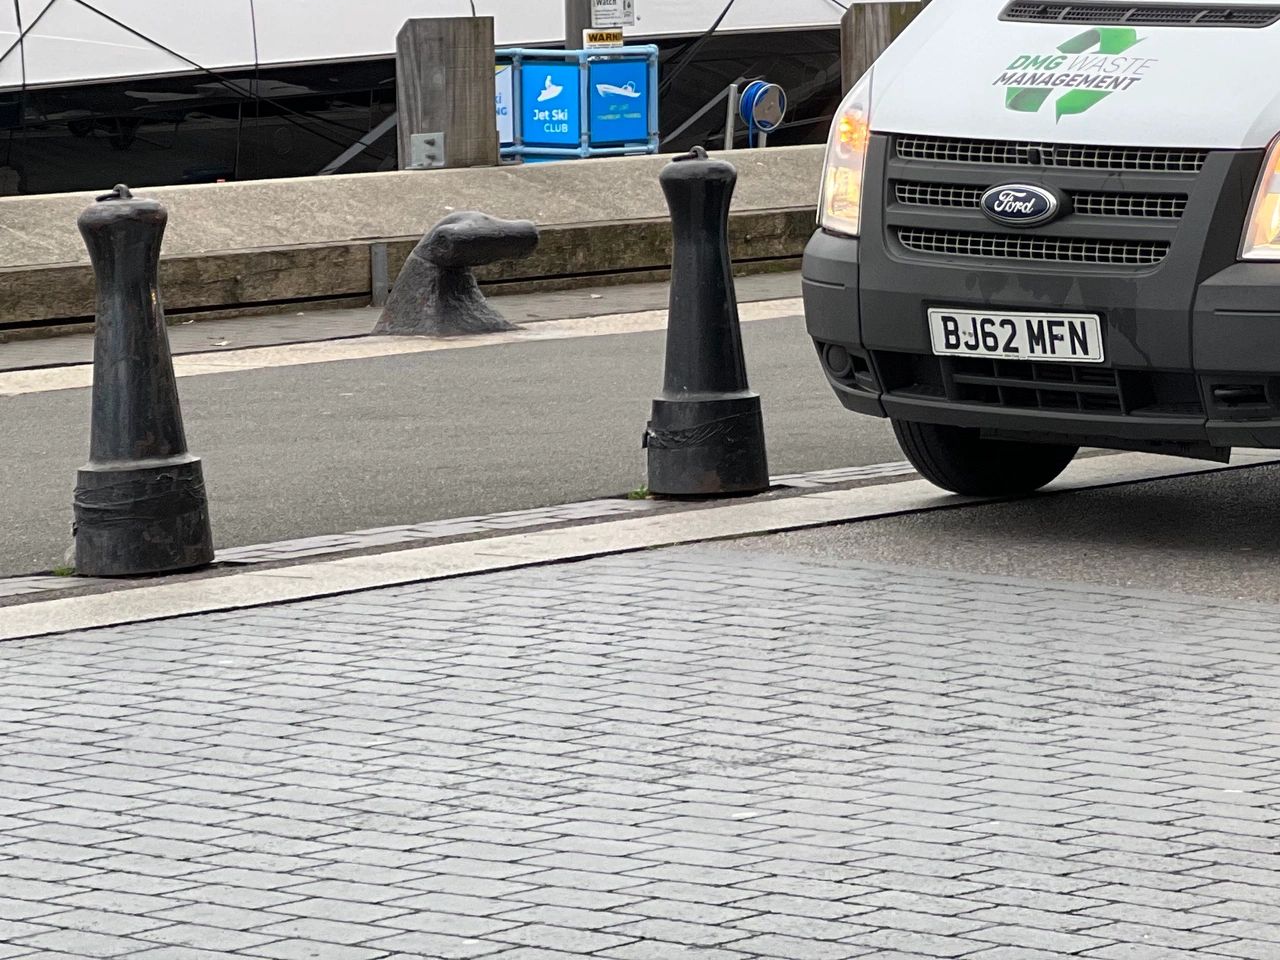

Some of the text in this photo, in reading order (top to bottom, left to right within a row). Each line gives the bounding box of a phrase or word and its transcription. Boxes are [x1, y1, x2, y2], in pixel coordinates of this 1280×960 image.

[588, 32, 623, 41] WARN
[1006, 55, 1159, 76] DMG WASTE
[992, 72, 1142, 91] MANAGEMENT
[533, 109, 568, 121] Jet Ski
[544, 123, 568, 133] CLUB
[993, 190, 1036, 214] Ford
[941, 315, 1089, 356] BJ62 MFN
